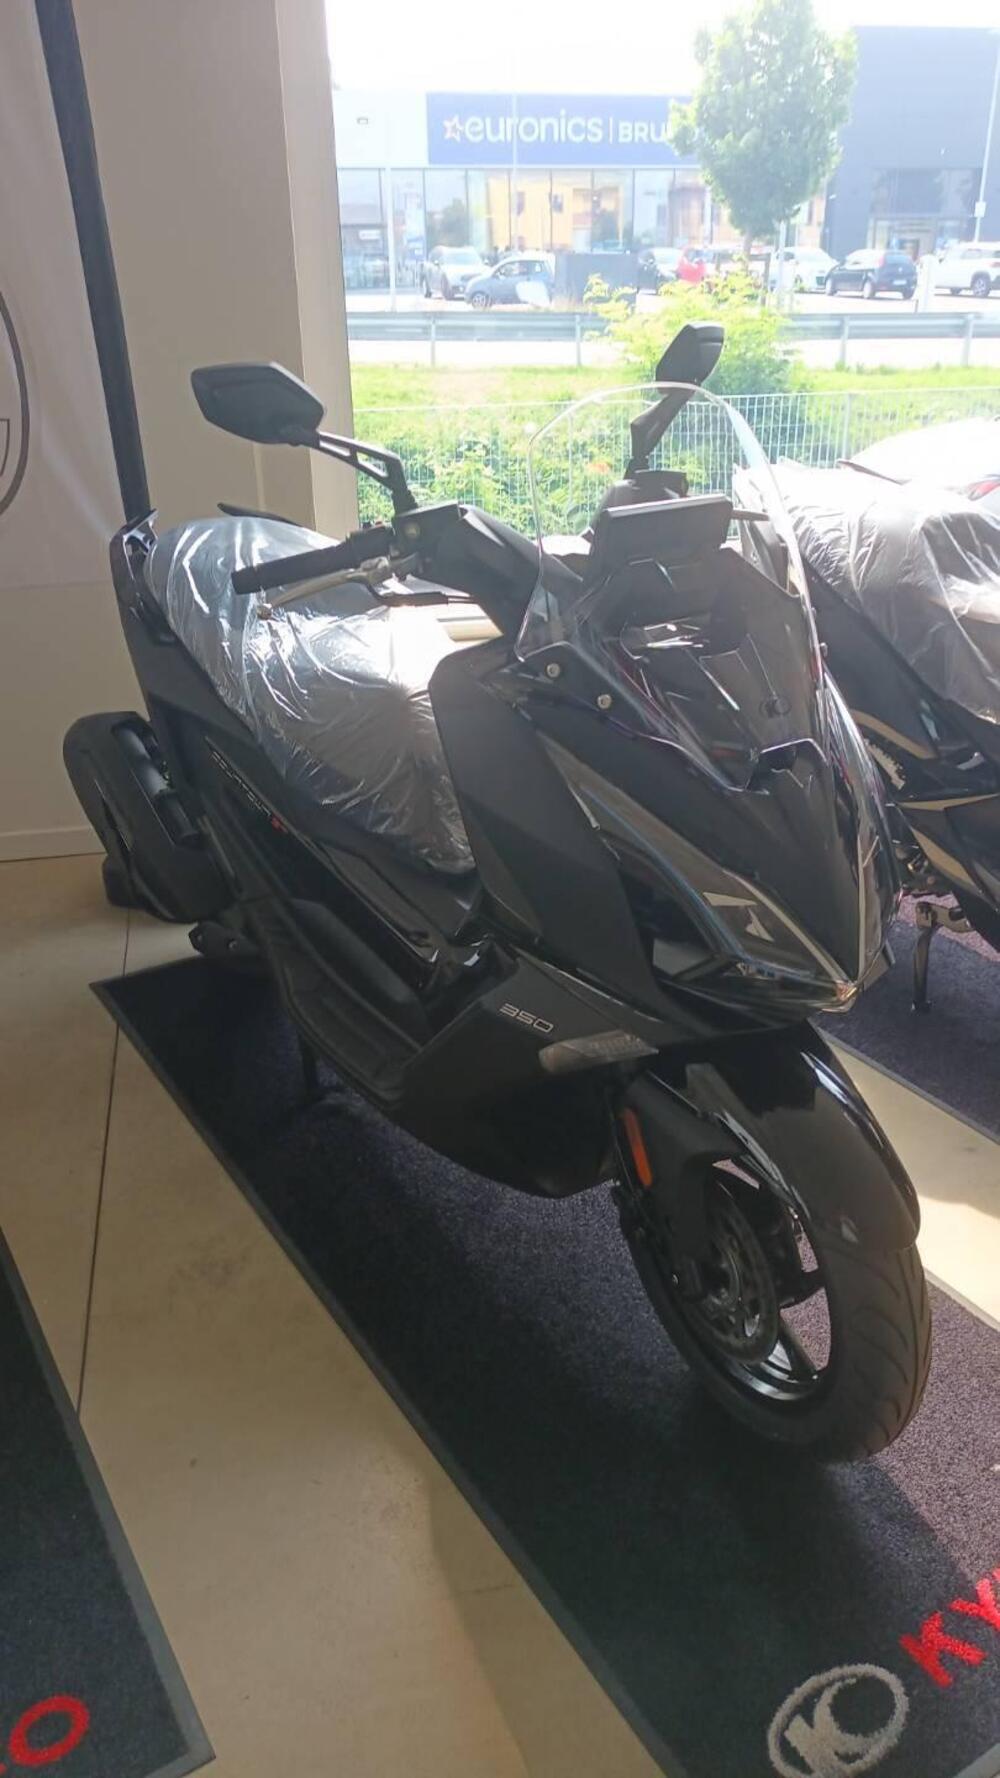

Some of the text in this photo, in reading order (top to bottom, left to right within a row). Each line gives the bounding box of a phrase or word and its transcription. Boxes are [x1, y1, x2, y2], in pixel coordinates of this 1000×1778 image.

[464, 108, 668, 143] euronics BRU
[500, 1003, 554, 1033] 350
[898, 1567, 1000, 1688] KY
[0, 1694, 89, 1776] O
